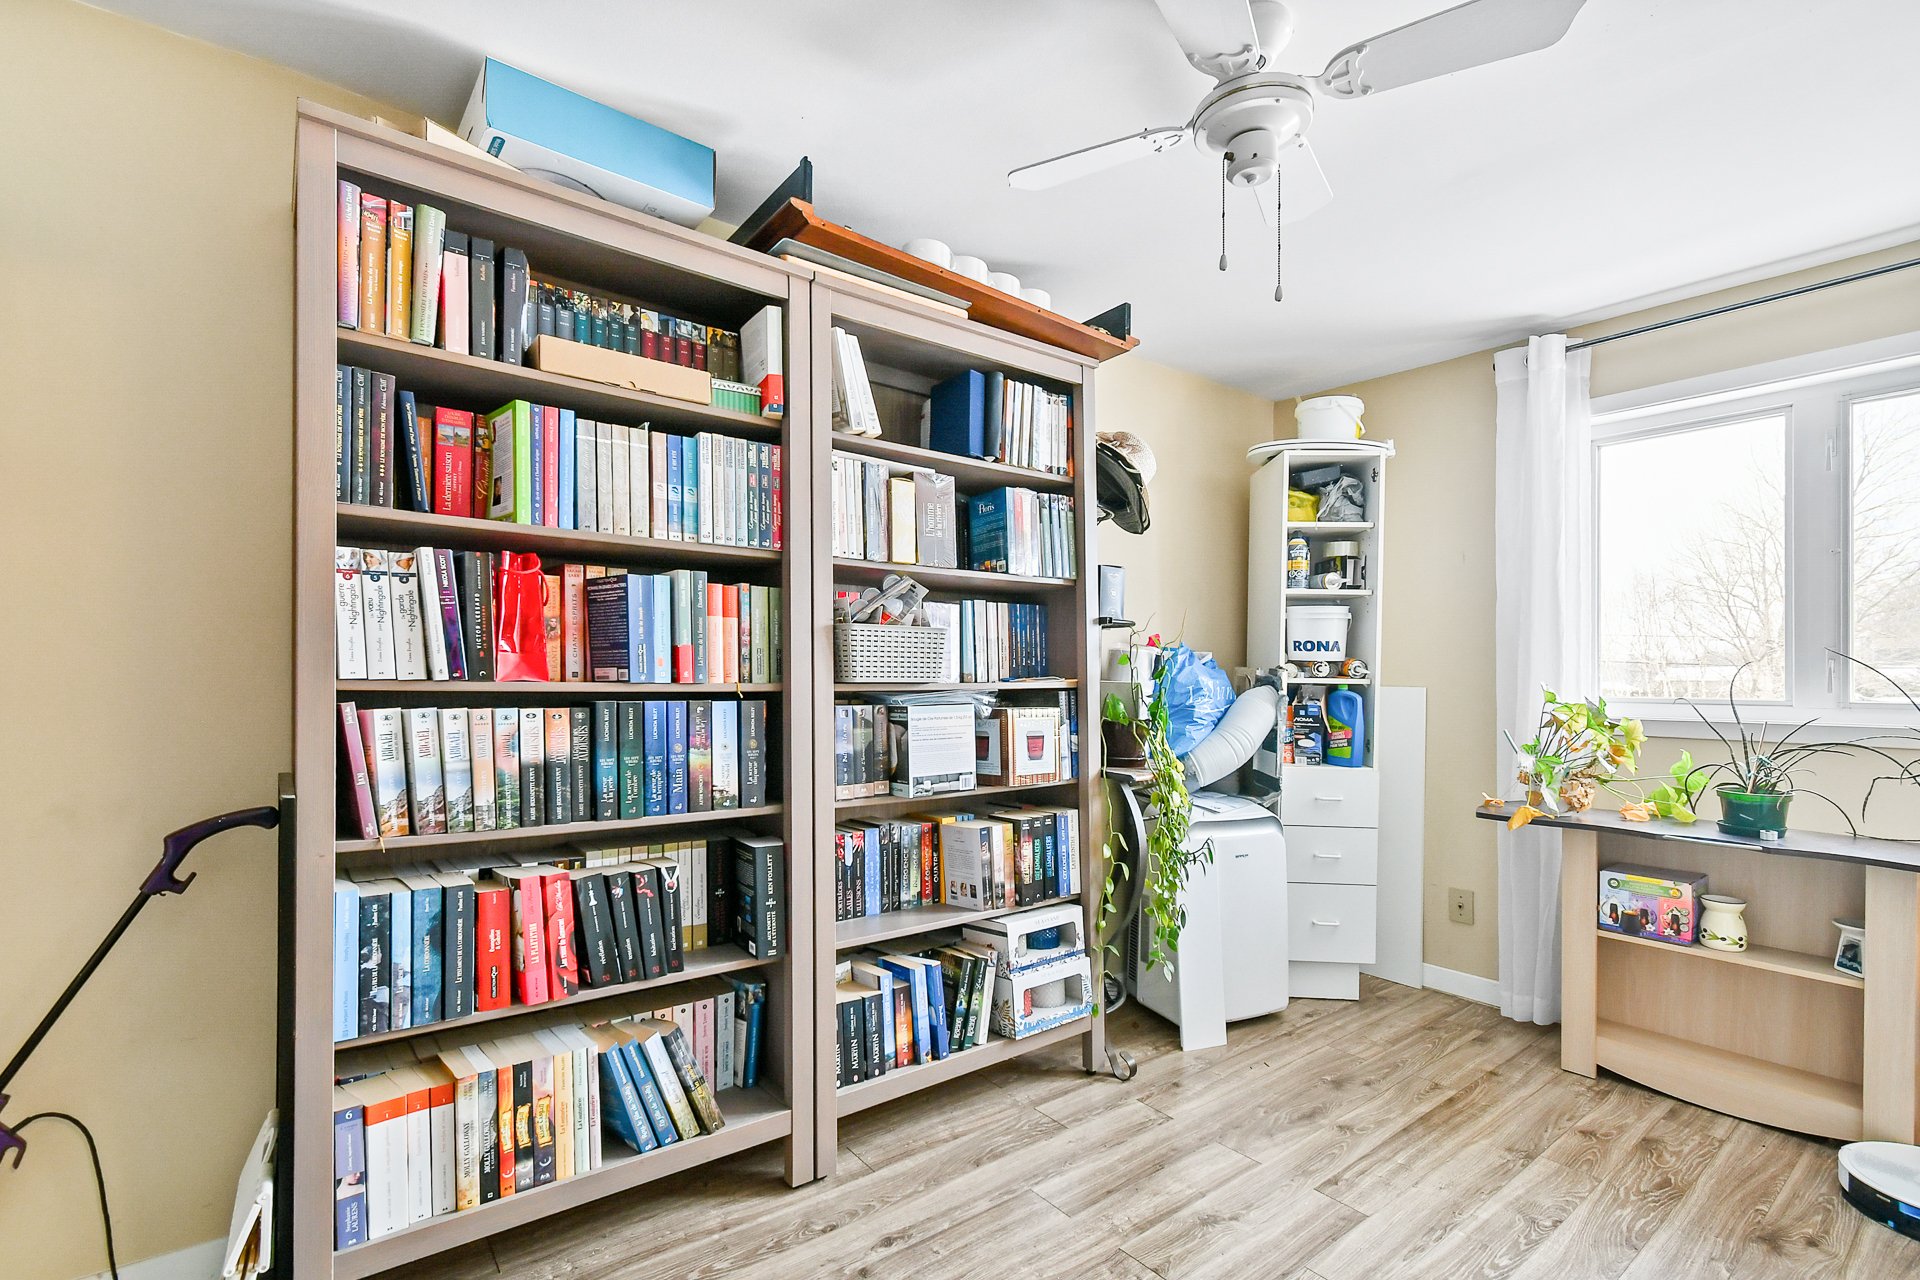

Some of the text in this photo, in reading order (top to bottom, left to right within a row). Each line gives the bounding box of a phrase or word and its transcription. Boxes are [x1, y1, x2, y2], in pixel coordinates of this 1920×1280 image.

[926, 503, 935, 536] L'homme
[338, 583, 348, 607] guerre
[348, 583, 359, 625] Nightingale
[375, 585, 387, 624] Nightingale
[396, 594, 407, 614] garde
[404, 590, 416, 628] Nightingale
[1293, 640, 1340, 652] RONA
[673, 768, 683, 793] Maia
[463, 1157, 471, 1178] MOLLY
[483, 1152, 491, 1173] MOLLY
[351, 1202, 359, 1232] LAURENS
